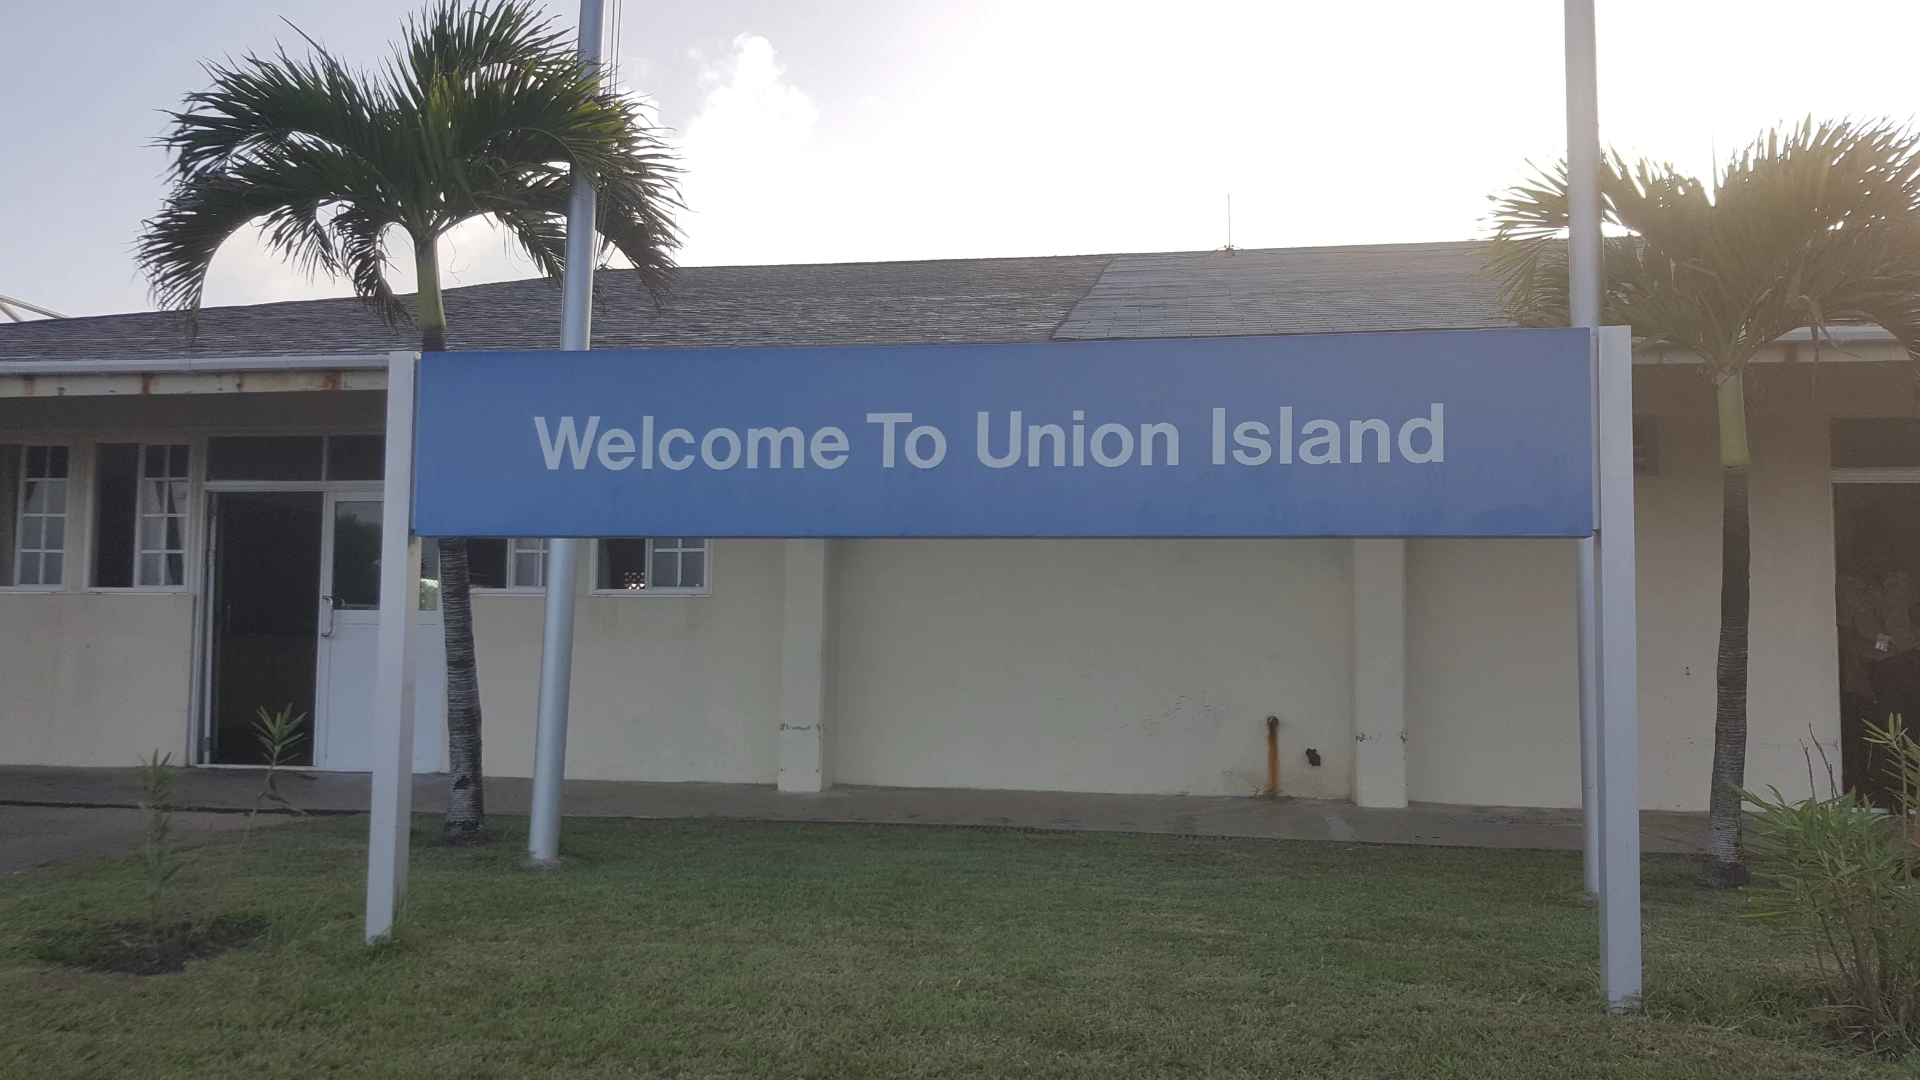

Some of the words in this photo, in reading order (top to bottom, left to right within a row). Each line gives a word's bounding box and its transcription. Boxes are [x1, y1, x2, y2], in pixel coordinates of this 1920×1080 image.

[534, 416, 850, 471] Welcome
[866, 412, 947, 469] To
[976, 410, 1180, 468] Union
[1212, 403, 1444, 466] Island
